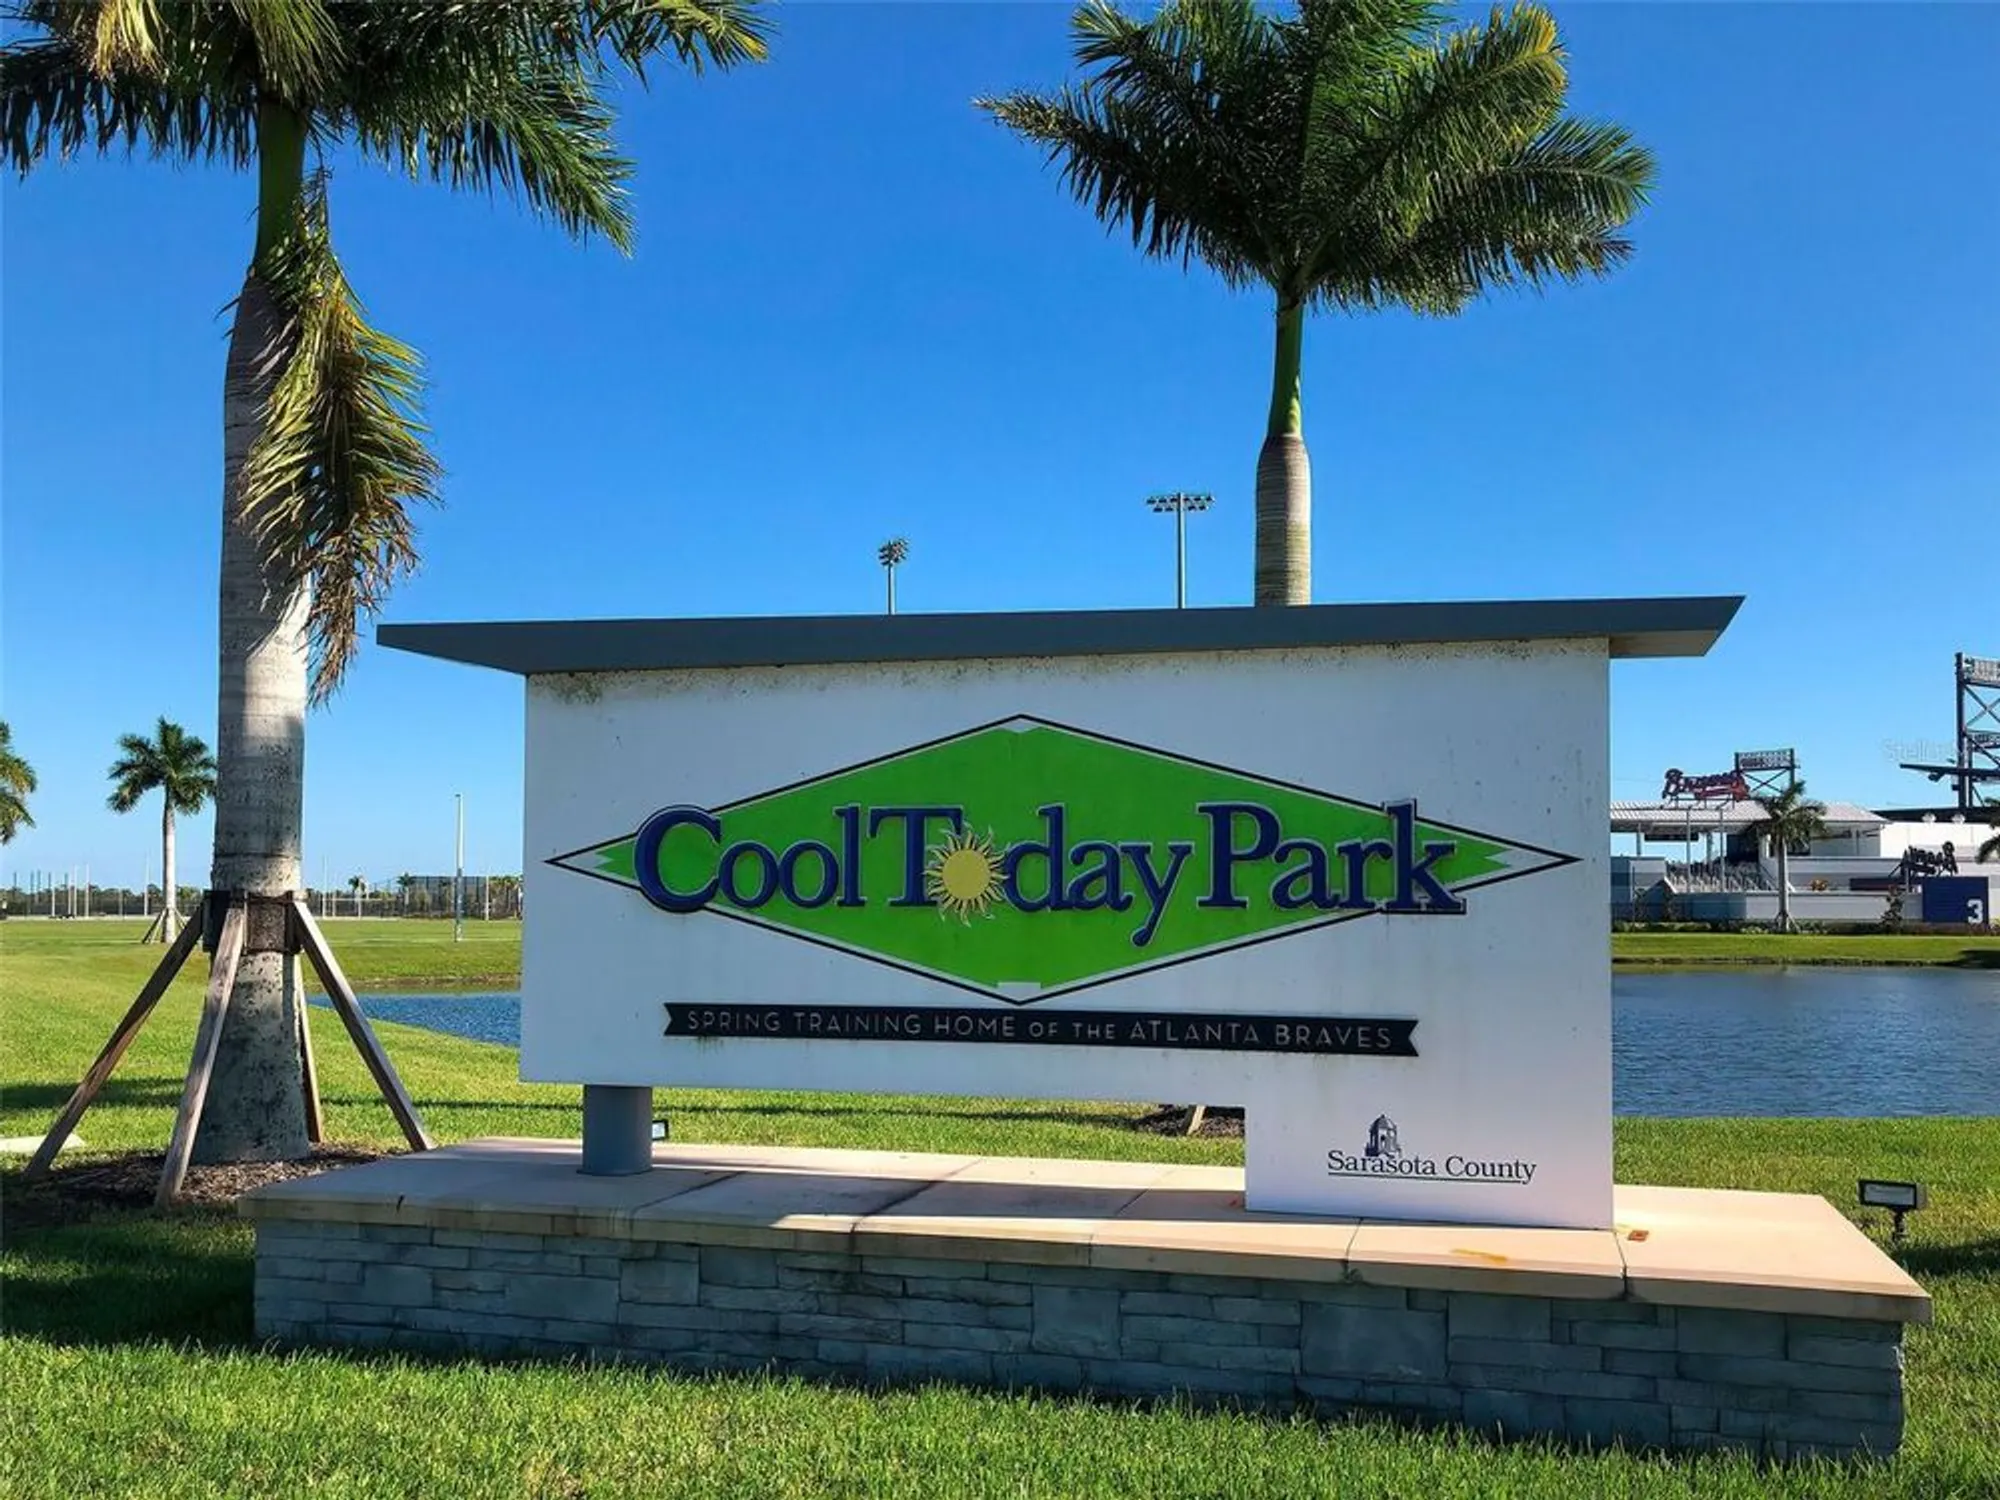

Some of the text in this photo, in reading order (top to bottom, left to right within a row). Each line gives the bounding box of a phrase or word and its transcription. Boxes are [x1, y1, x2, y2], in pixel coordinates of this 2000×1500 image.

[1199, 798, 1467, 914] Park
[1967, 899, 1983, 923] 3
[687, 1009, 1392, 1049] SPRING TRAINING HOME OF THE ATLANTA BRAVES
[1328, 1148, 1537, 1185] Sarasota County
